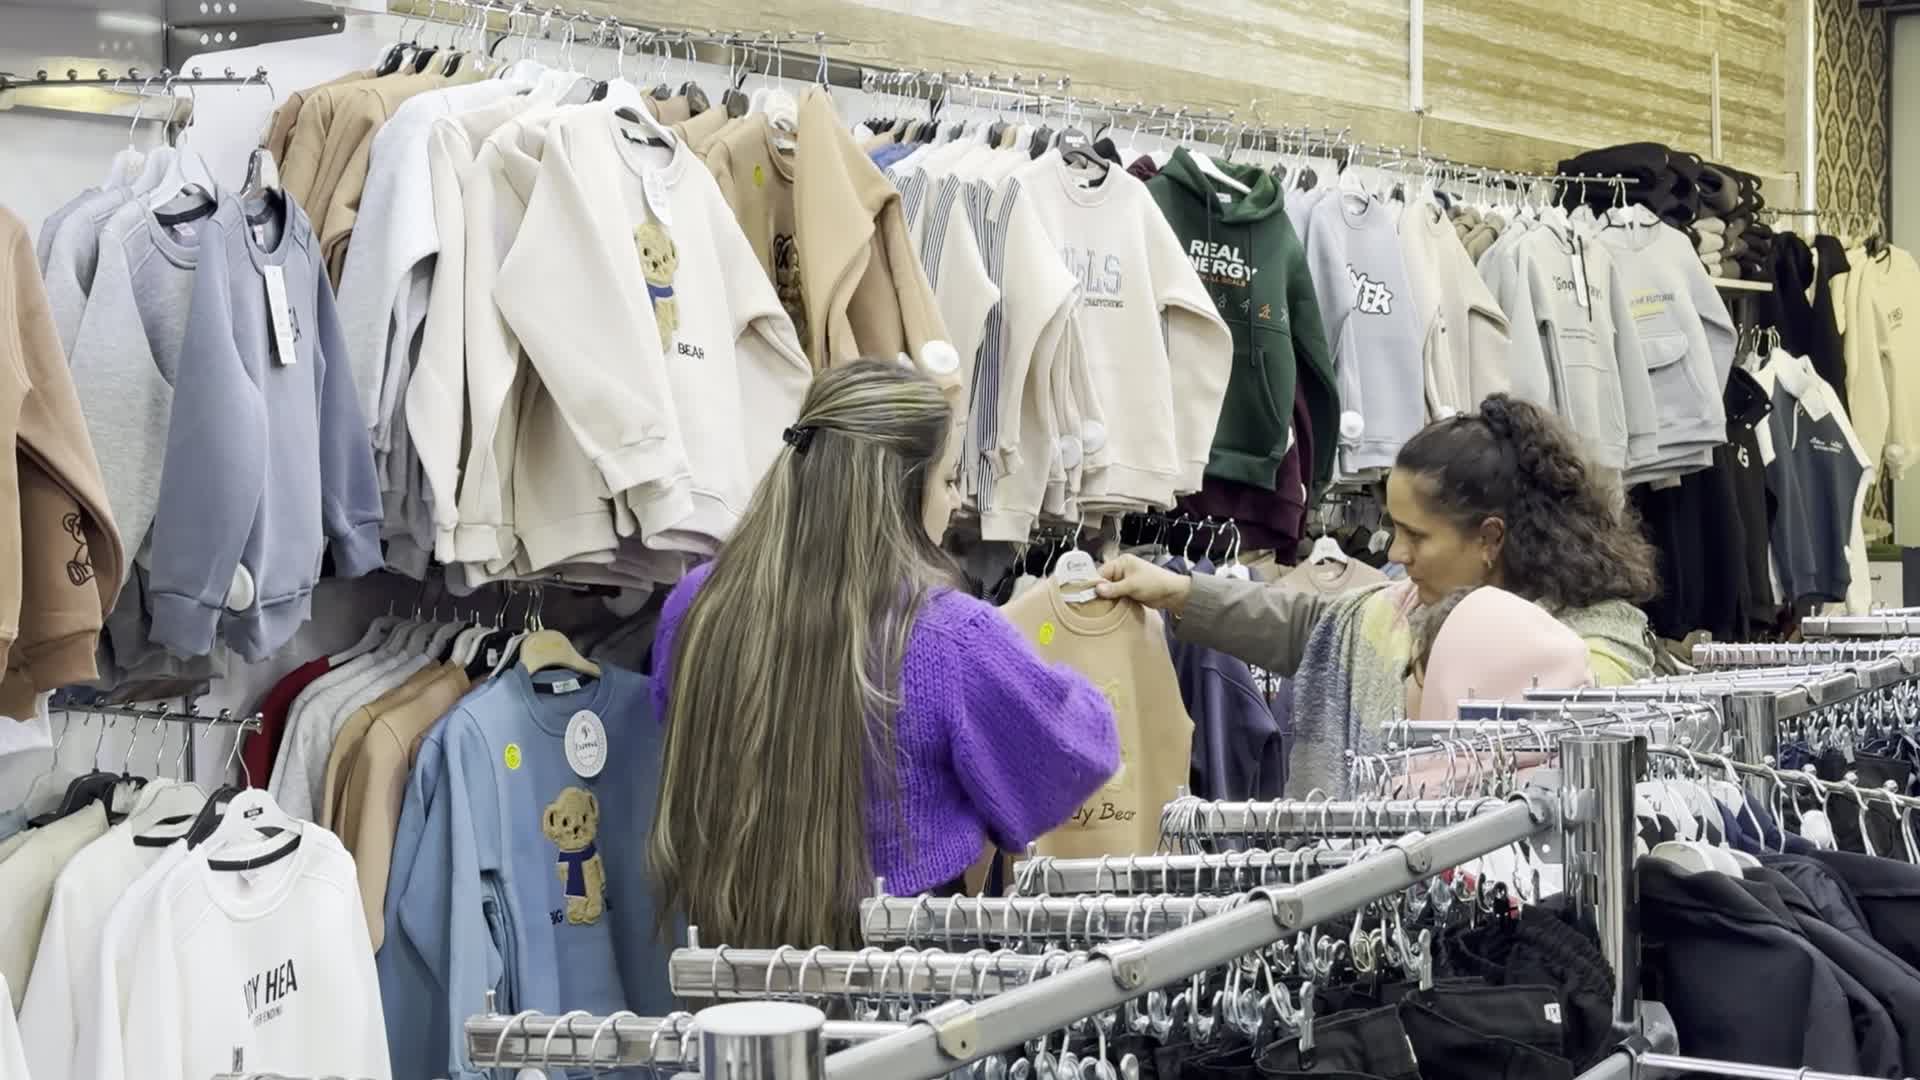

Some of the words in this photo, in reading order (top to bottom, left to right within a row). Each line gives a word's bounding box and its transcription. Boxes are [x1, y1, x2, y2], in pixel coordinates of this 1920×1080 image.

[1190, 240, 1245, 264] REAL
[1188, 255, 1258, 281] NERGY
[677, 341, 705, 361] BEAR
[1099, 802, 1137, 821] Bear
